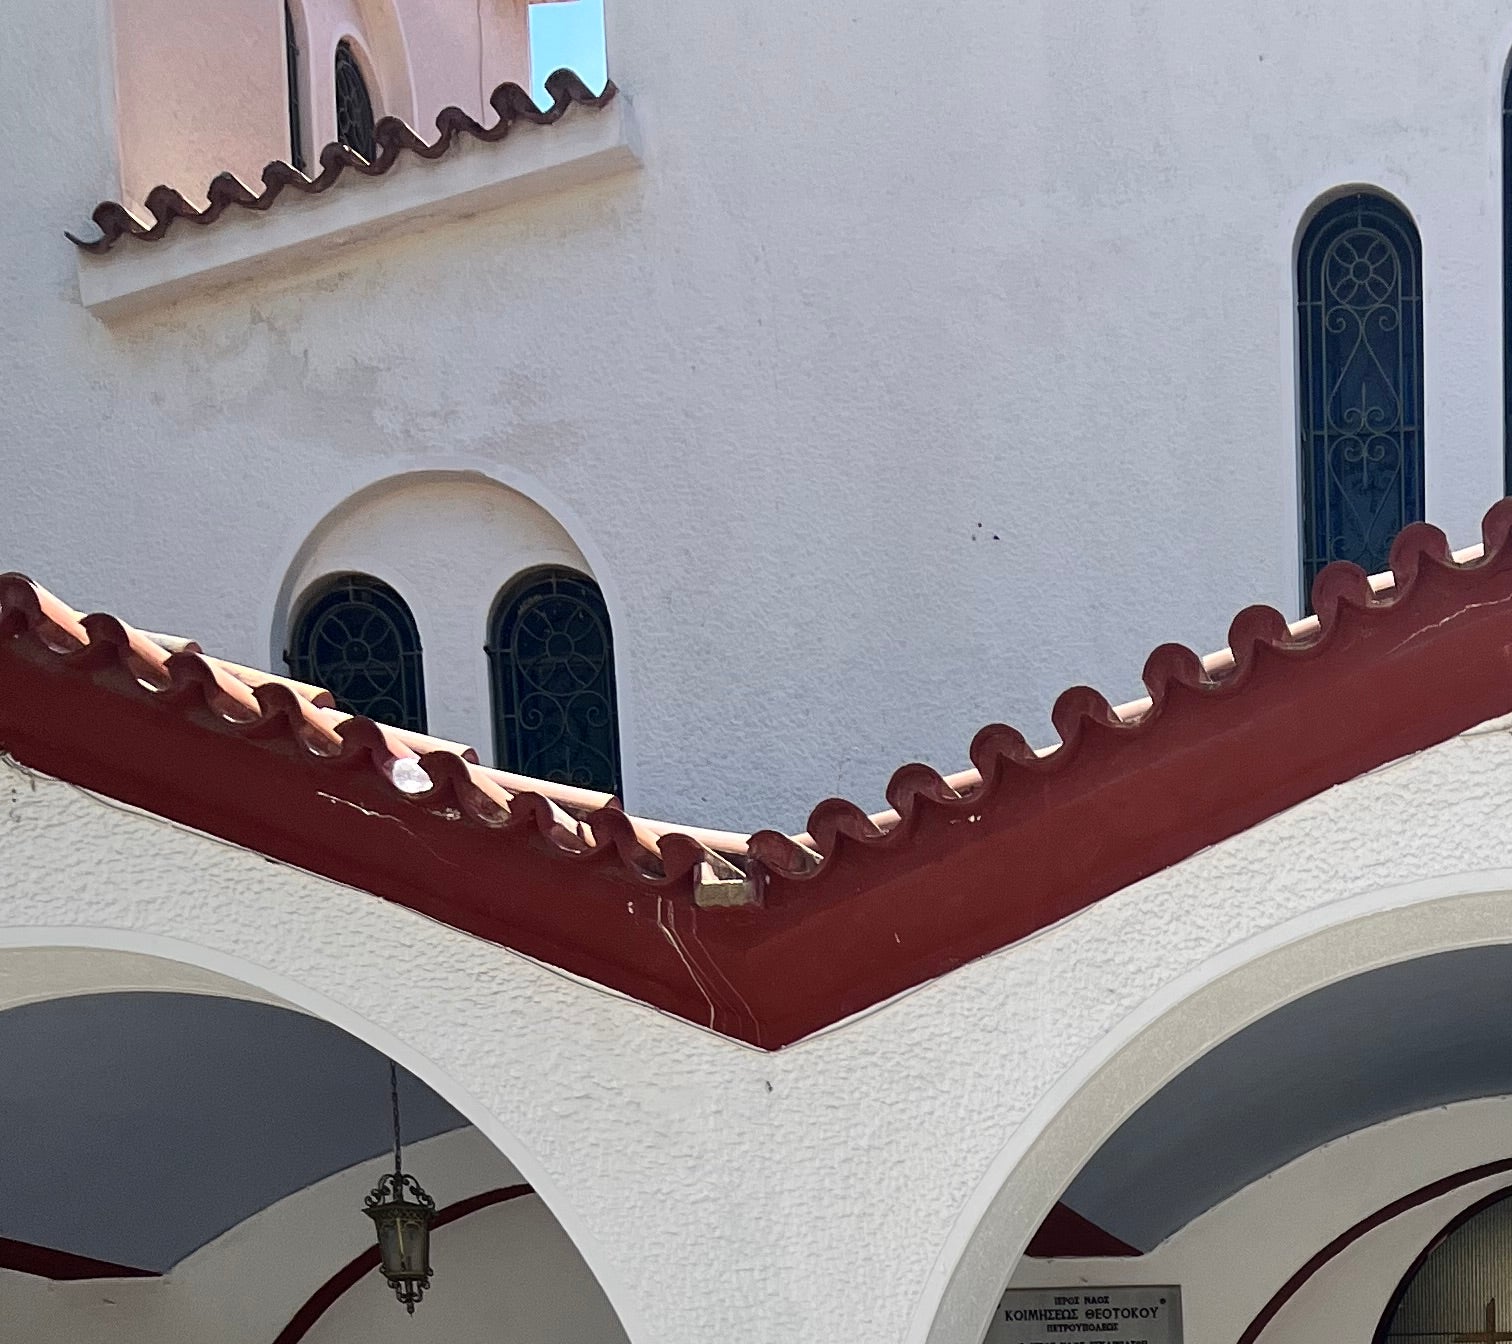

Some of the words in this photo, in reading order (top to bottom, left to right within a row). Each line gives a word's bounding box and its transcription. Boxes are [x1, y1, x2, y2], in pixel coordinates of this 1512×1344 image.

[1084, 1296, 1110, 1305] ΝΑΟΣ
[1005, 1309, 1079, 1321] ΚΟΙΜΗΣΕΩΣ
[1085, 1307, 1159, 1319] ΘΕΟΤΟΚΟΥ
